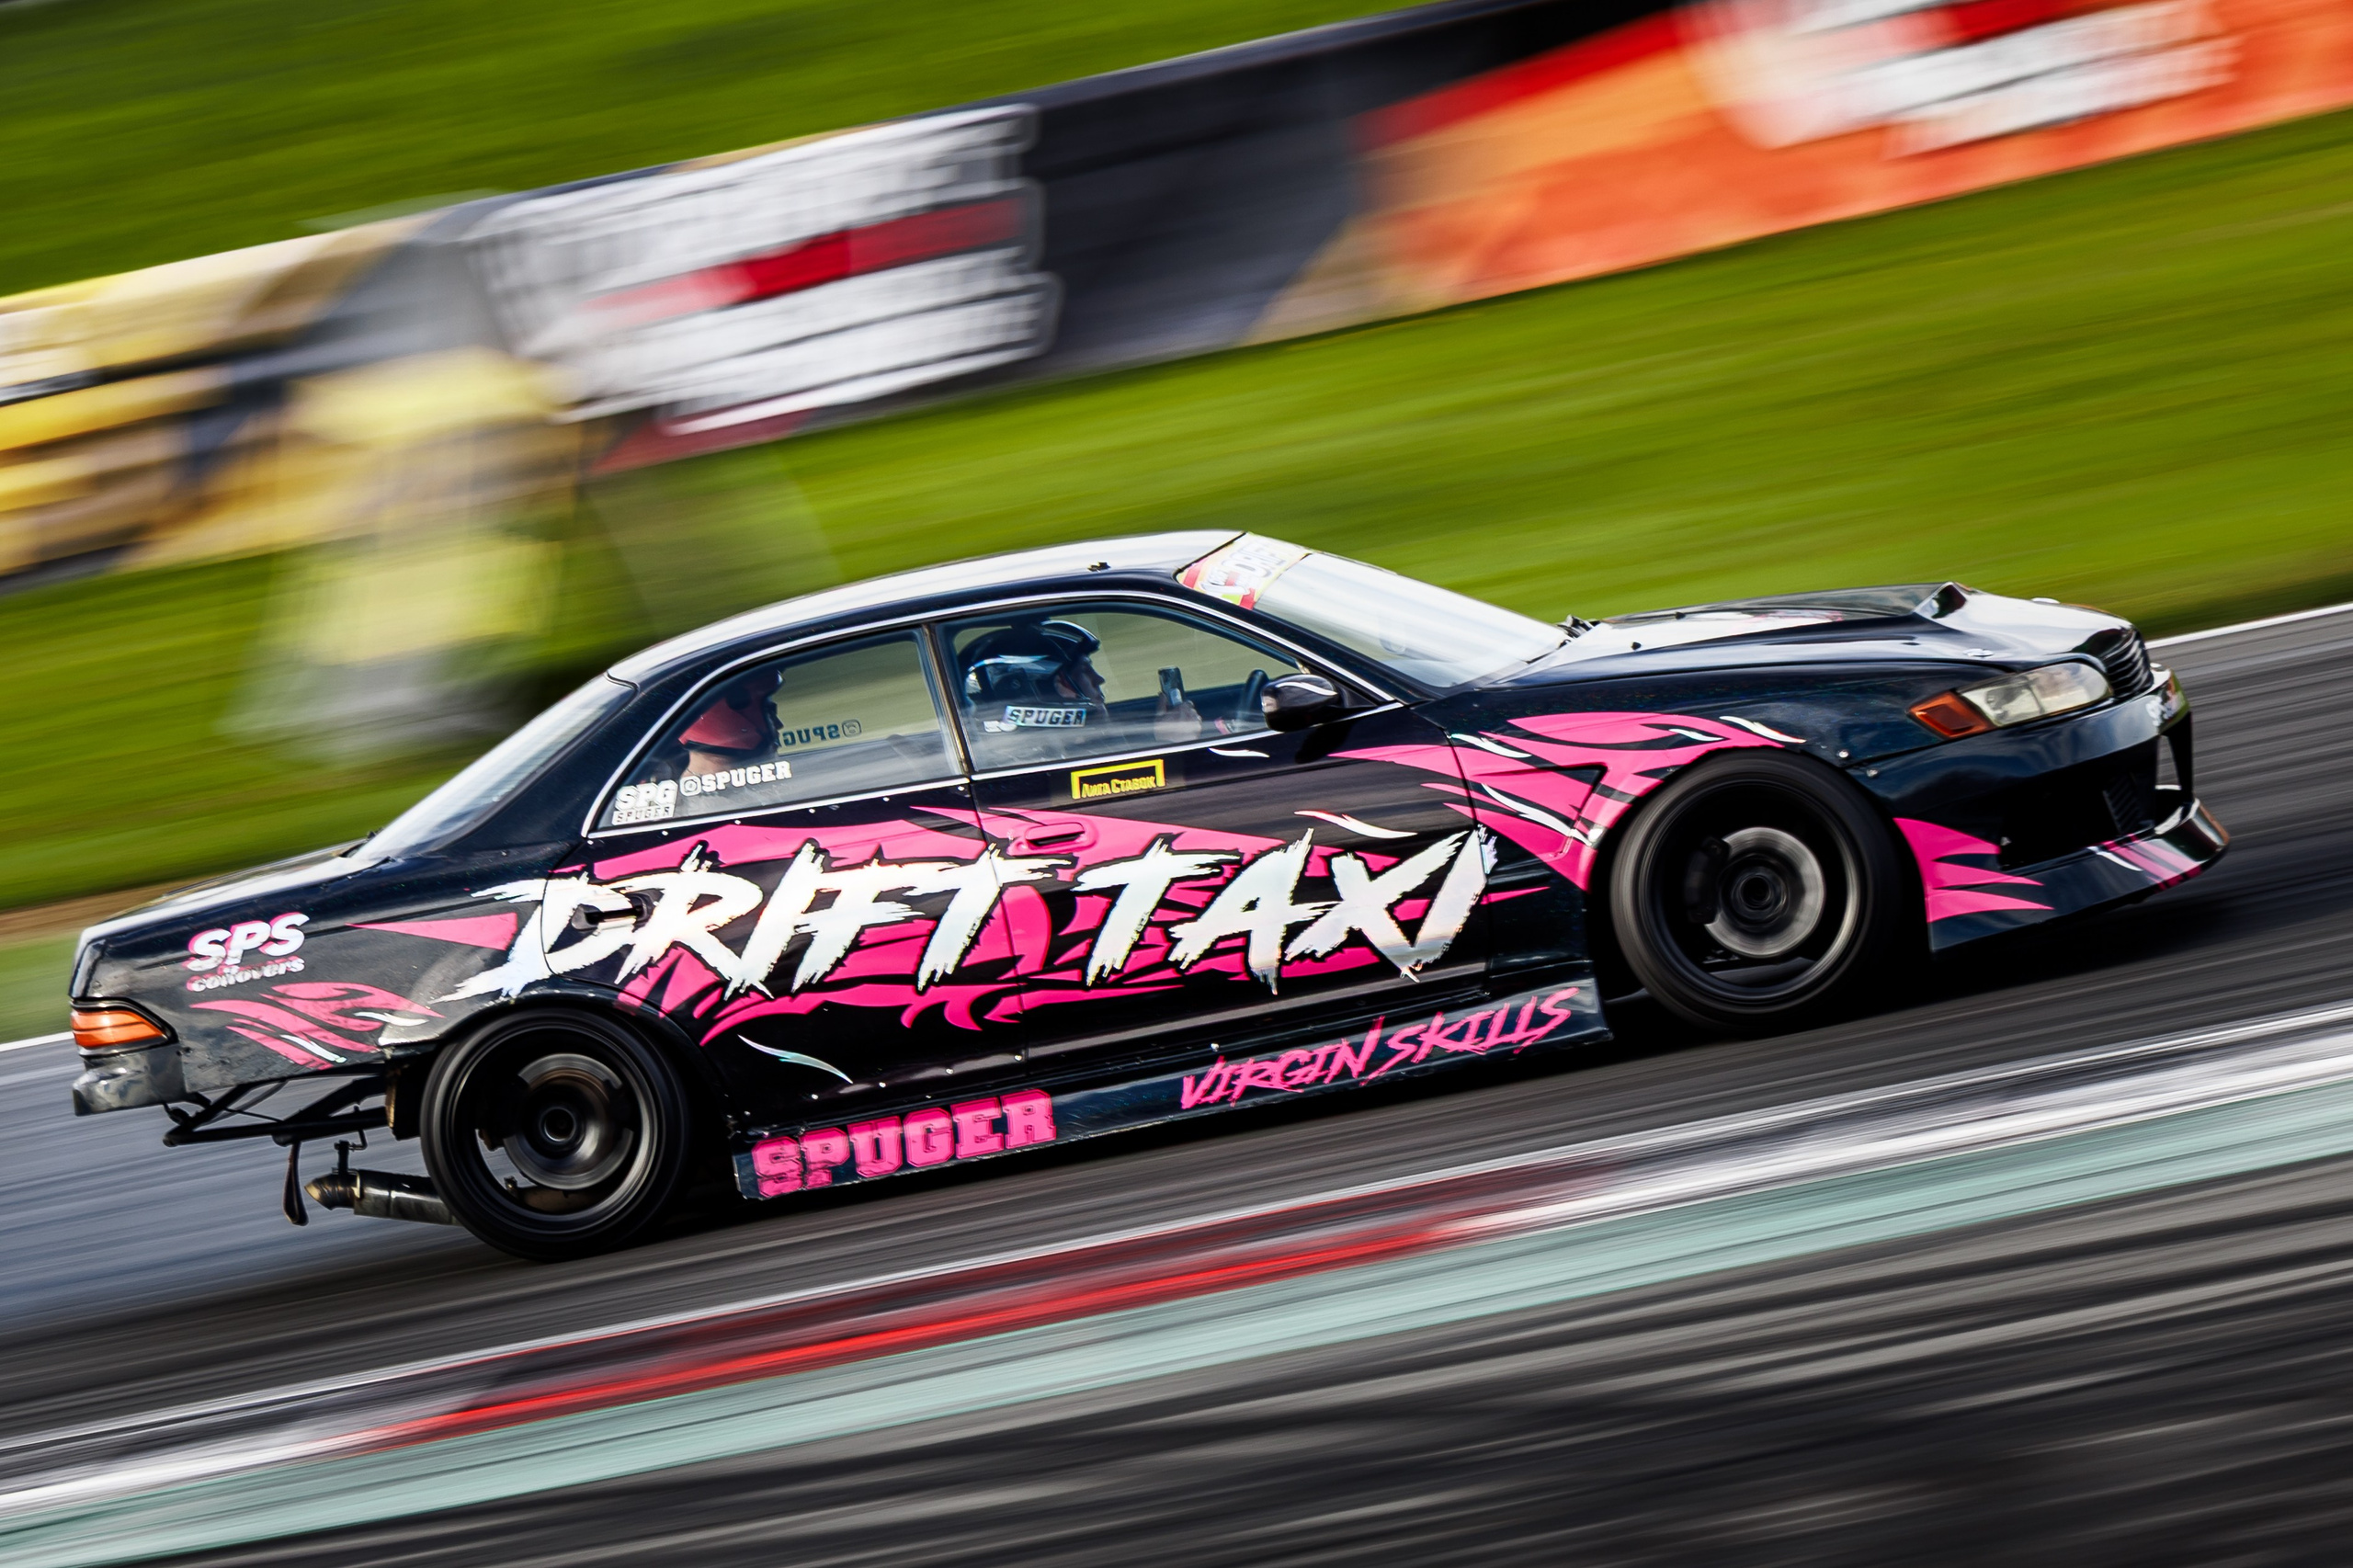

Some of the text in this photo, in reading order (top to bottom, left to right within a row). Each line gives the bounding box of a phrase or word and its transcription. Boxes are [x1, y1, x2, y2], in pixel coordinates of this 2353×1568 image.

[1008, 709, 1084, 725] SPUGER
[615, 779, 678, 812] SPG
[181, 912, 310, 971] SPS
[428, 824, 1498, 1000] DRIFT TAXI
[1181, 986, 1579, 1108] VIRGIN SKILLS
[751, 1089, 1057, 1199] SPUGER
